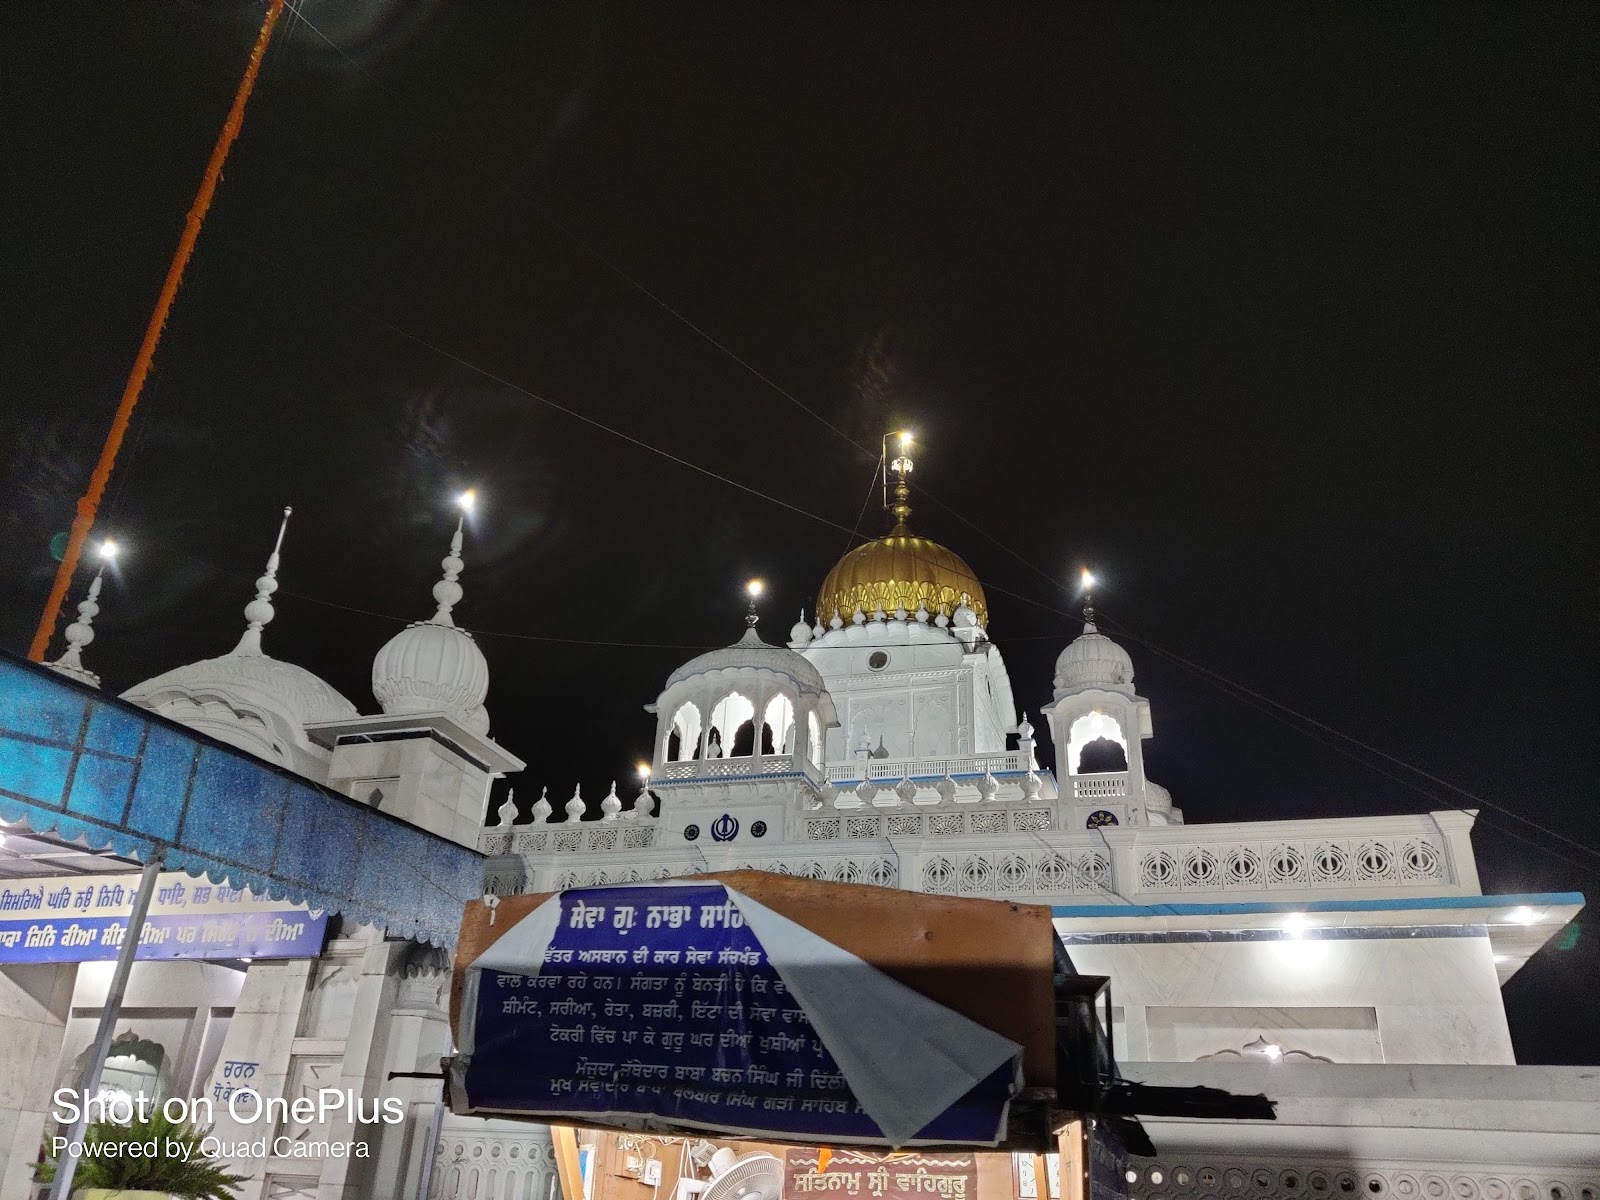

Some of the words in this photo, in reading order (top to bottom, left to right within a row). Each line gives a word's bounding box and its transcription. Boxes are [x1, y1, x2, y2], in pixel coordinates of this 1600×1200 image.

[570, 900, 606, 929] ਸੇਵਾ
[700, 900, 746, 929] ਸਾਹਿ
[0, 929, 23, 948] ਾਕਾ
[61, 924, 98, 947] ਕੀਆ
[545, 946, 575, 963] ਵੱਤਰ
[578, 949, 629, 964] ਅਸਥਾਨ
[632, 945, 649, 964] ਦੀ
[653, 949, 681, 965] ਕਾਰ
[685, 946, 713, 965] ਸੇਵਾ
[567, 971, 589, 990] ਰਹੇ
[692, 972, 730, 993] ਬੇਨਤੀ
[750, 974, 769, 994] ਕਿ
[728, 1000, 745, 1020] ਦੀ
[749, 1002, 778, 1023] ਸੇਵਾ
[782, 1009, 811, 1025] ਵਾਸ
[549, 1024, 586, 1043] ਟੋਕਰੀ
[590, 1024, 617, 1044] ਵਿੱਚ
[621, 1030, 639, 1045] ਪਾ
[643, 1026, 657, 1046] ਕੇ
[661, 1031, 686, 1053] ਗੁਰੂ
[690, 1032, 715, 1047] ਘਰ
[224, 1061, 259, 1079] ਚਰਨ
[674, 1065, 707, 1082] ਬਾਬਾ
[711, 1067, 744, 1084] ਬਚਨ
[747, 1064, 781, 1087] ਸਿੰਘ
[786, 1066, 804, 1089] ਜੀ
[793, 1167, 861, 1195] ਸਤਿਨਾਮੁ
[896, 1167, 968, 1200] ਵਾਹਿਗੁਰੂ
